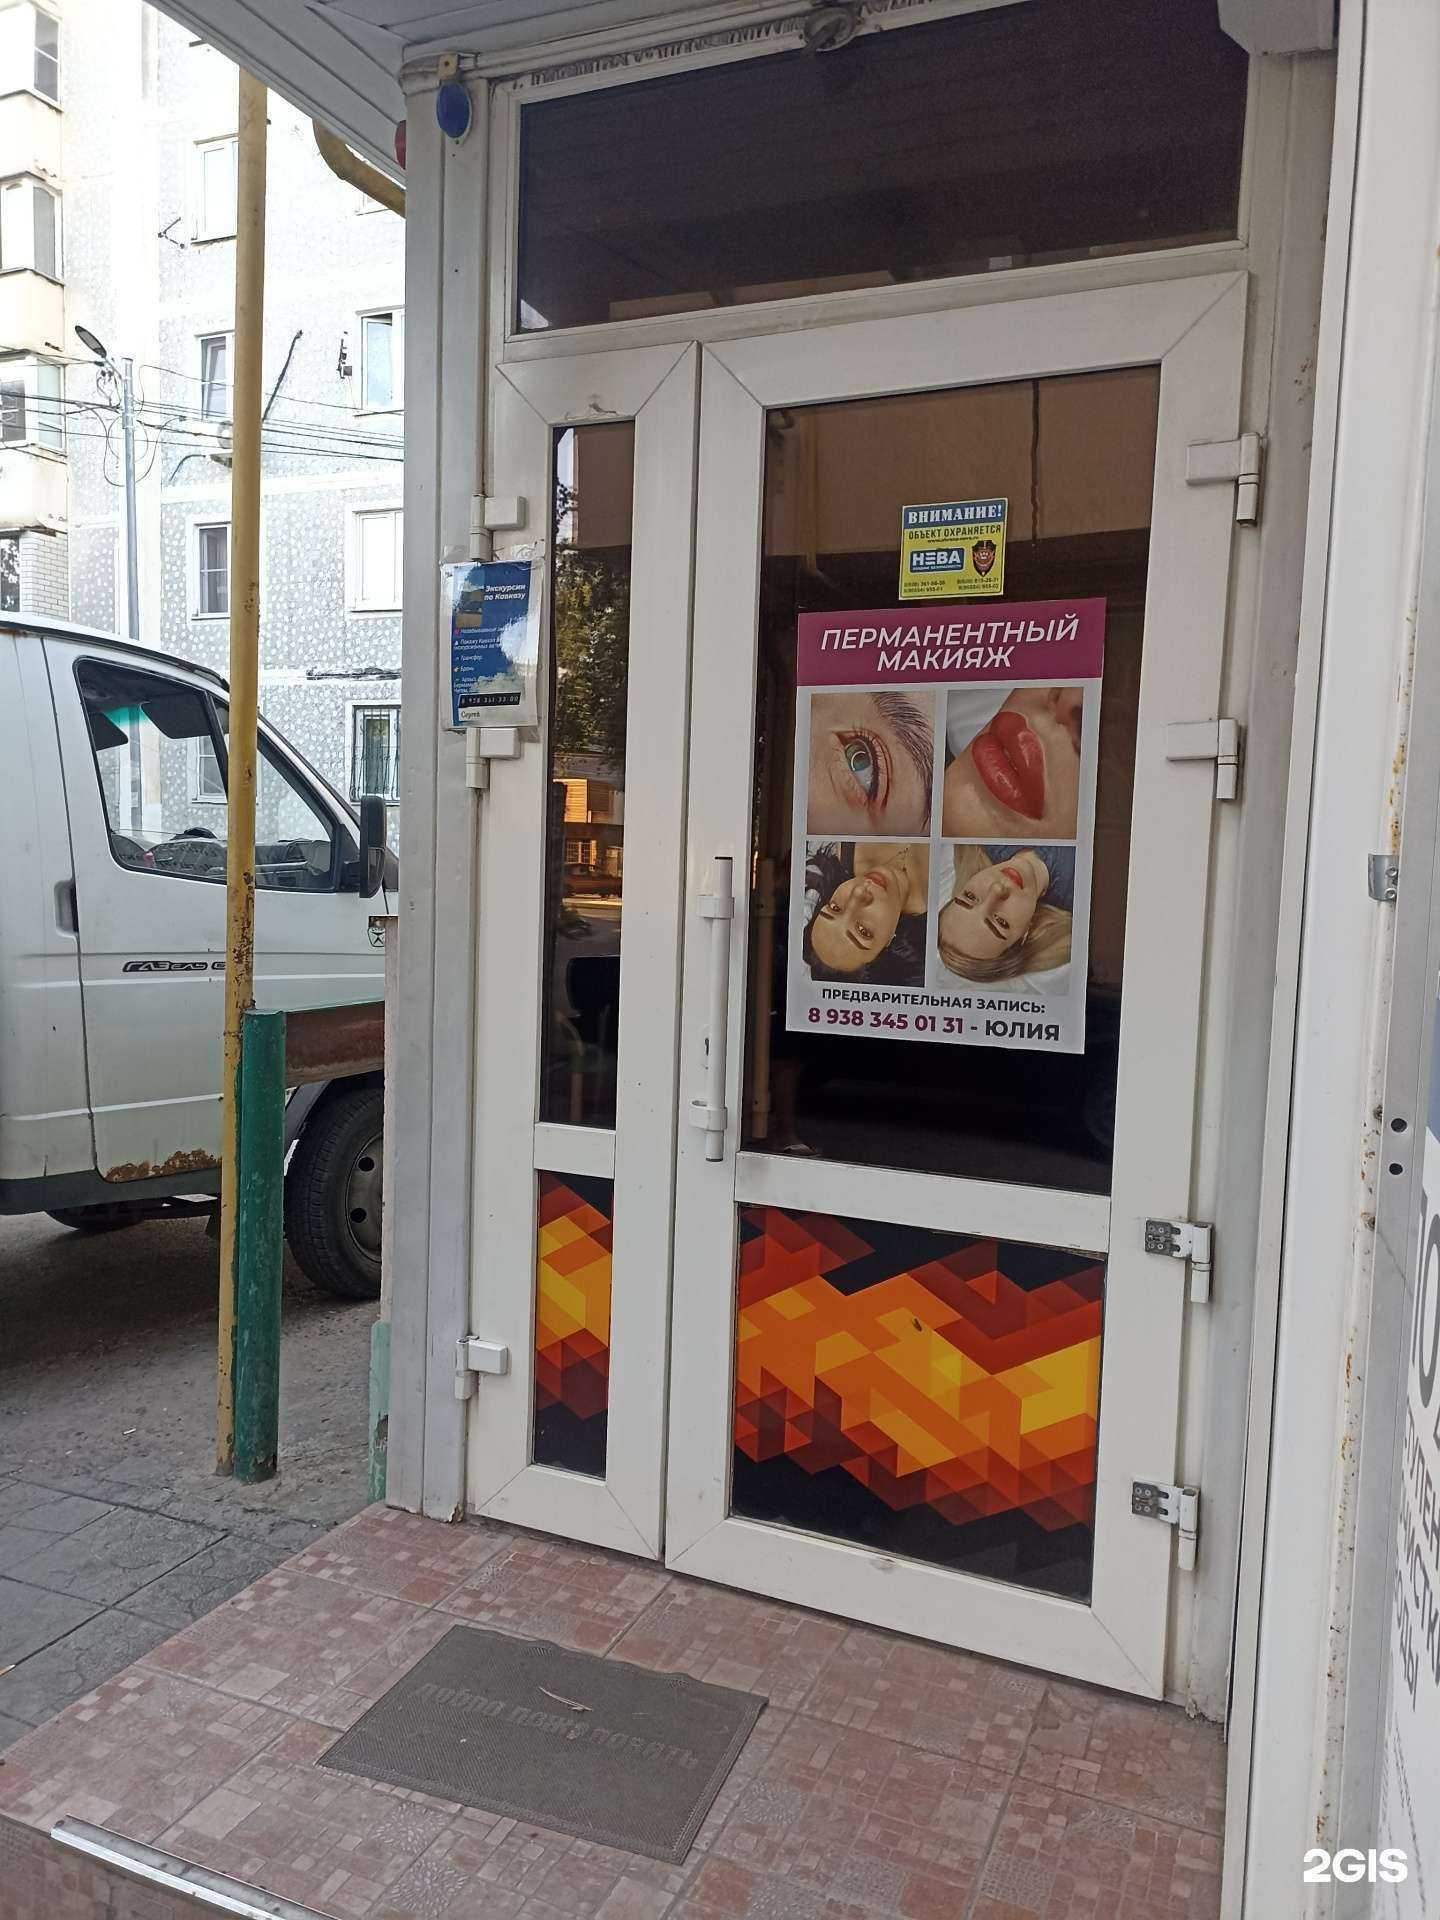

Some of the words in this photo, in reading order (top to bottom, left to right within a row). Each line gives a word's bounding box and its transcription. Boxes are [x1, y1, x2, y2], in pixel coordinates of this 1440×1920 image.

[908, 504, 1002, 524] ВНИМАНИЕ!
[908, 528, 942, 540] ОБЪЕКТ
[943, 525, 1001, 537] ОХРАНЯЕТСЯ
[912, 550, 961, 566] НЕВА
[485, 584, 526, 593] Экскурсии
[820, 613, 1080, 650] ПЕРМАНЕНТНЫЙ
[877, 646, 1016, 672] МАКИЯЖ
[822, 988, 972, 1009] ПРЕДВАРИТЕЛЬНАЯ
[977, 998, 1045, 1013] ЗАПИСЬ:
[808, 1007, 820, 1023] 8
[827, 1009, 864, 1026] 938
[870, 1012, 909, 1030] 345
[914, 1014, 936, 1032] 01
[942, 1016, 963, 1034] 31
[985, 1020, 1060, 1041] ЮЛИЯ
